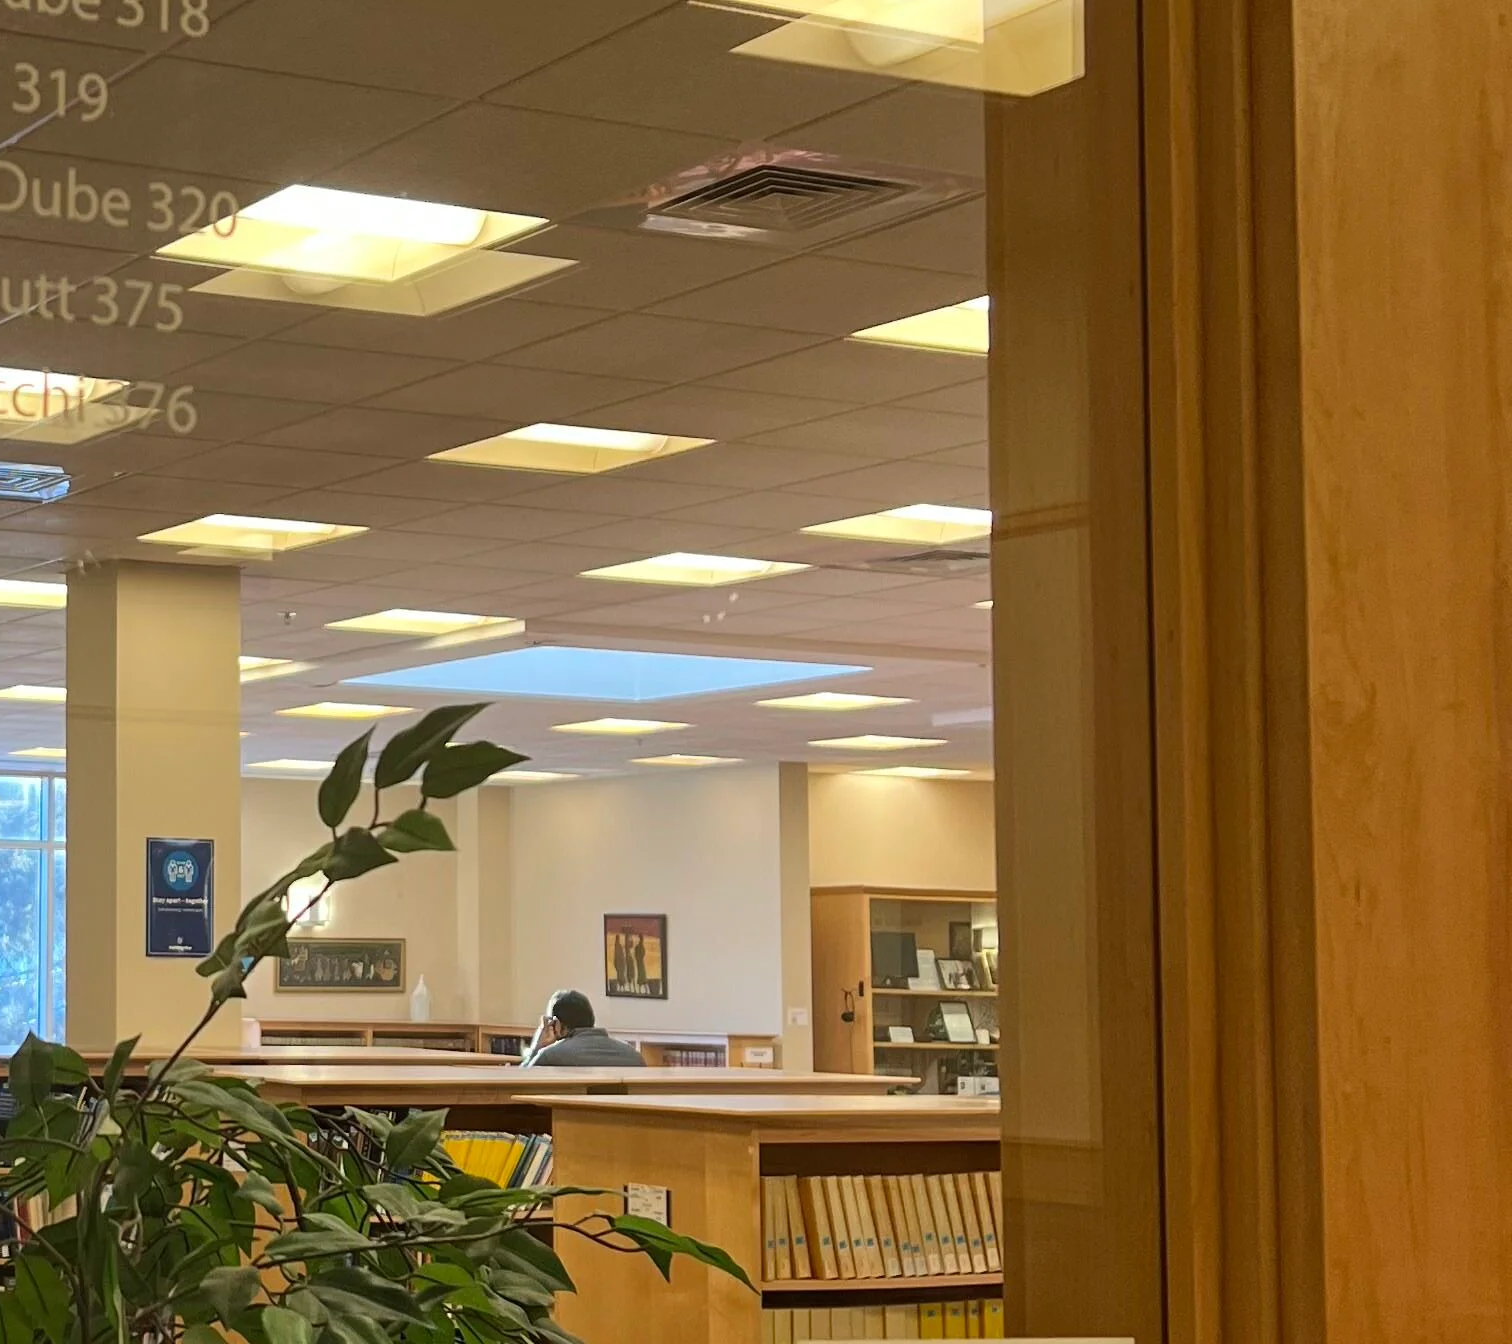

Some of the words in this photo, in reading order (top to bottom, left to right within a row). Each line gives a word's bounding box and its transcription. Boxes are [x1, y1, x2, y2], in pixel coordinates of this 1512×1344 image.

[12, 62, 108, 122] 319
[147, 182, 238, 240] 320
[91, 277, 185, 332] 375
[104, 379, 198, 434] 376
